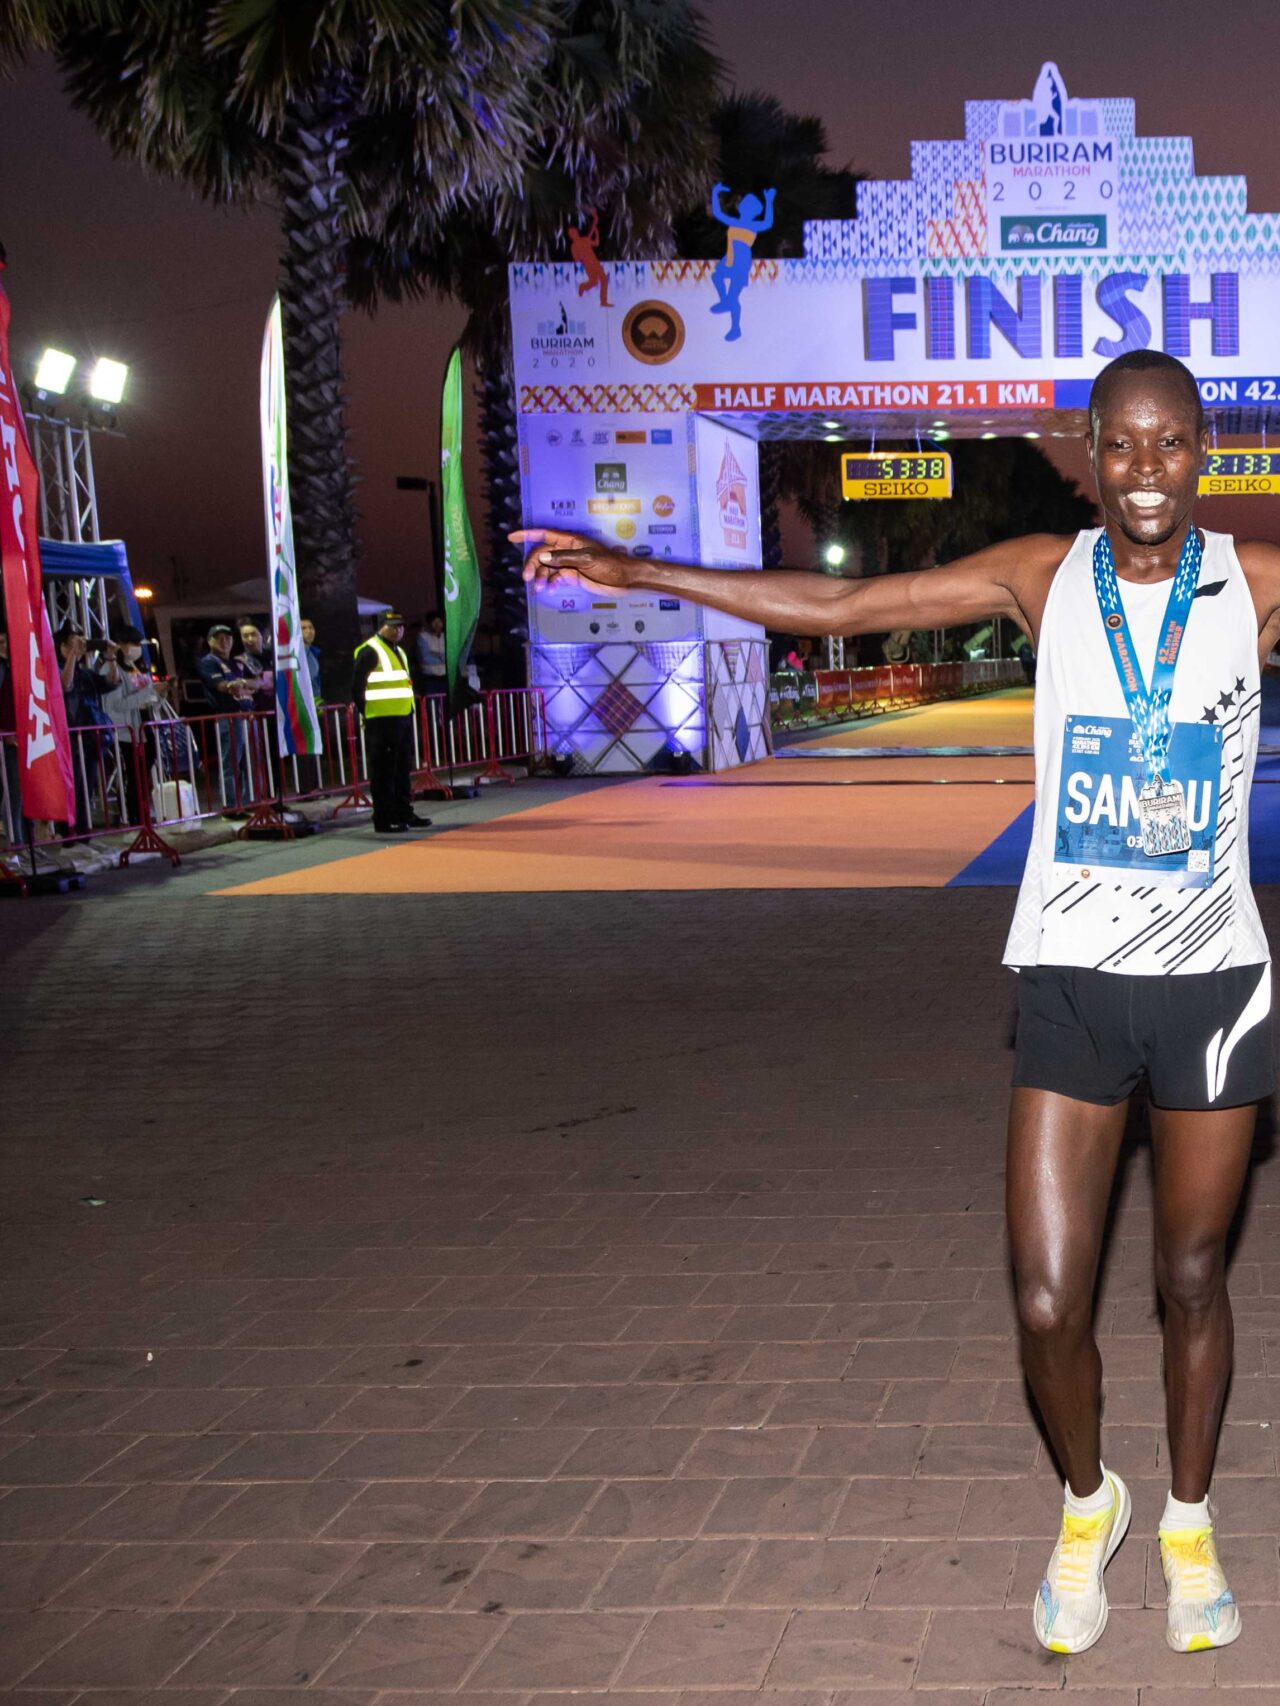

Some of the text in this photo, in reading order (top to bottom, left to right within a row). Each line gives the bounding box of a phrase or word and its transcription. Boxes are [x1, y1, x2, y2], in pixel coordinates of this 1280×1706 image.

[990, 142, 1113, 165] BURIRAM
[1013, 165, 1091, 177] MARATHON
[1036, 222, 1099, 246] Chang
[862, 272, 1240, 361] FINISH
[530, 336, 595, 350] BURIRAM
[714, 383, 1046, 407] HALF MARATHON 21.1 KM.
[1199, 380, 1238, 401] ON
[863, 481, 929, 496] SEIKO
[1208, 478, 1272, 492] SEIKO
[1114, 632, 1138, 692] MARATHON
[1085, 724, 1113, 738] Chang
[1142, 795, 1182, 808] BURIRAM
